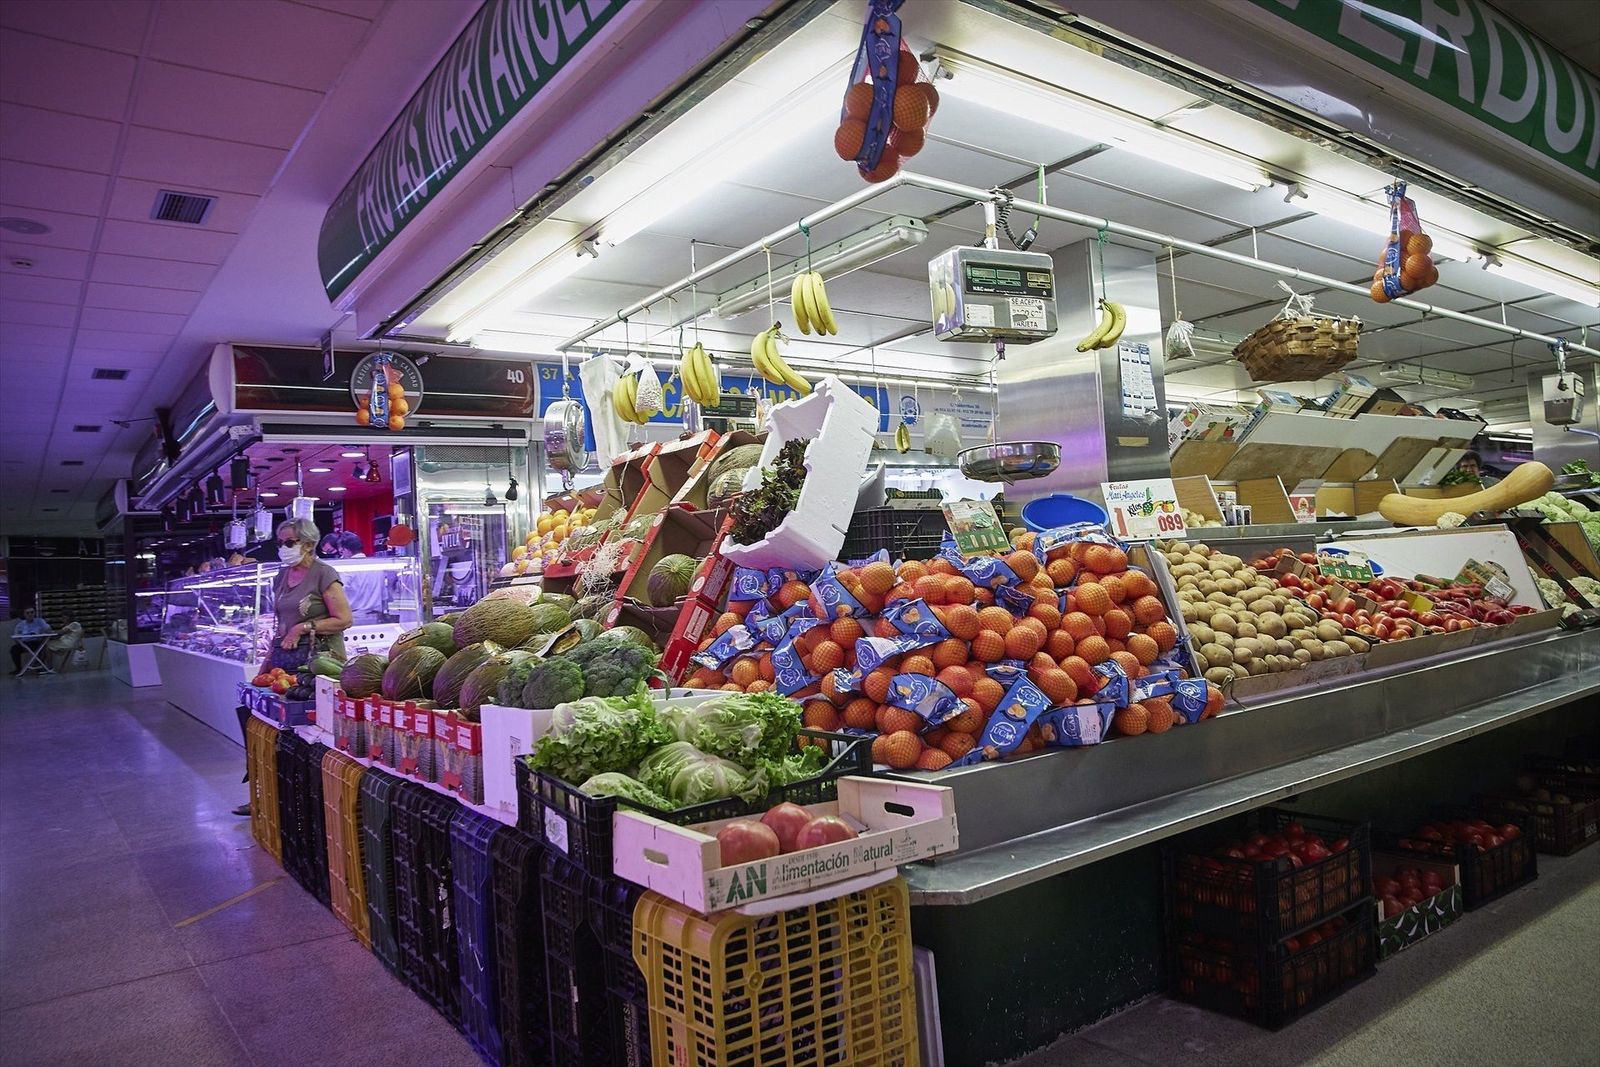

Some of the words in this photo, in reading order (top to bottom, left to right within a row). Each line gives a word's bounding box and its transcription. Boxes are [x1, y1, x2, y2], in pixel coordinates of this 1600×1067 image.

[426, 4, 492, 180] MARI
[401, 362, 419, 388] CALIDAD
[506, 369, 524, 384] 40
[542, 367, 558, 381] 37
[726, 863, 767, 904] AN
[773, 851, 850, 884] Alimentación
[853, 838, 894, 865] Natural
